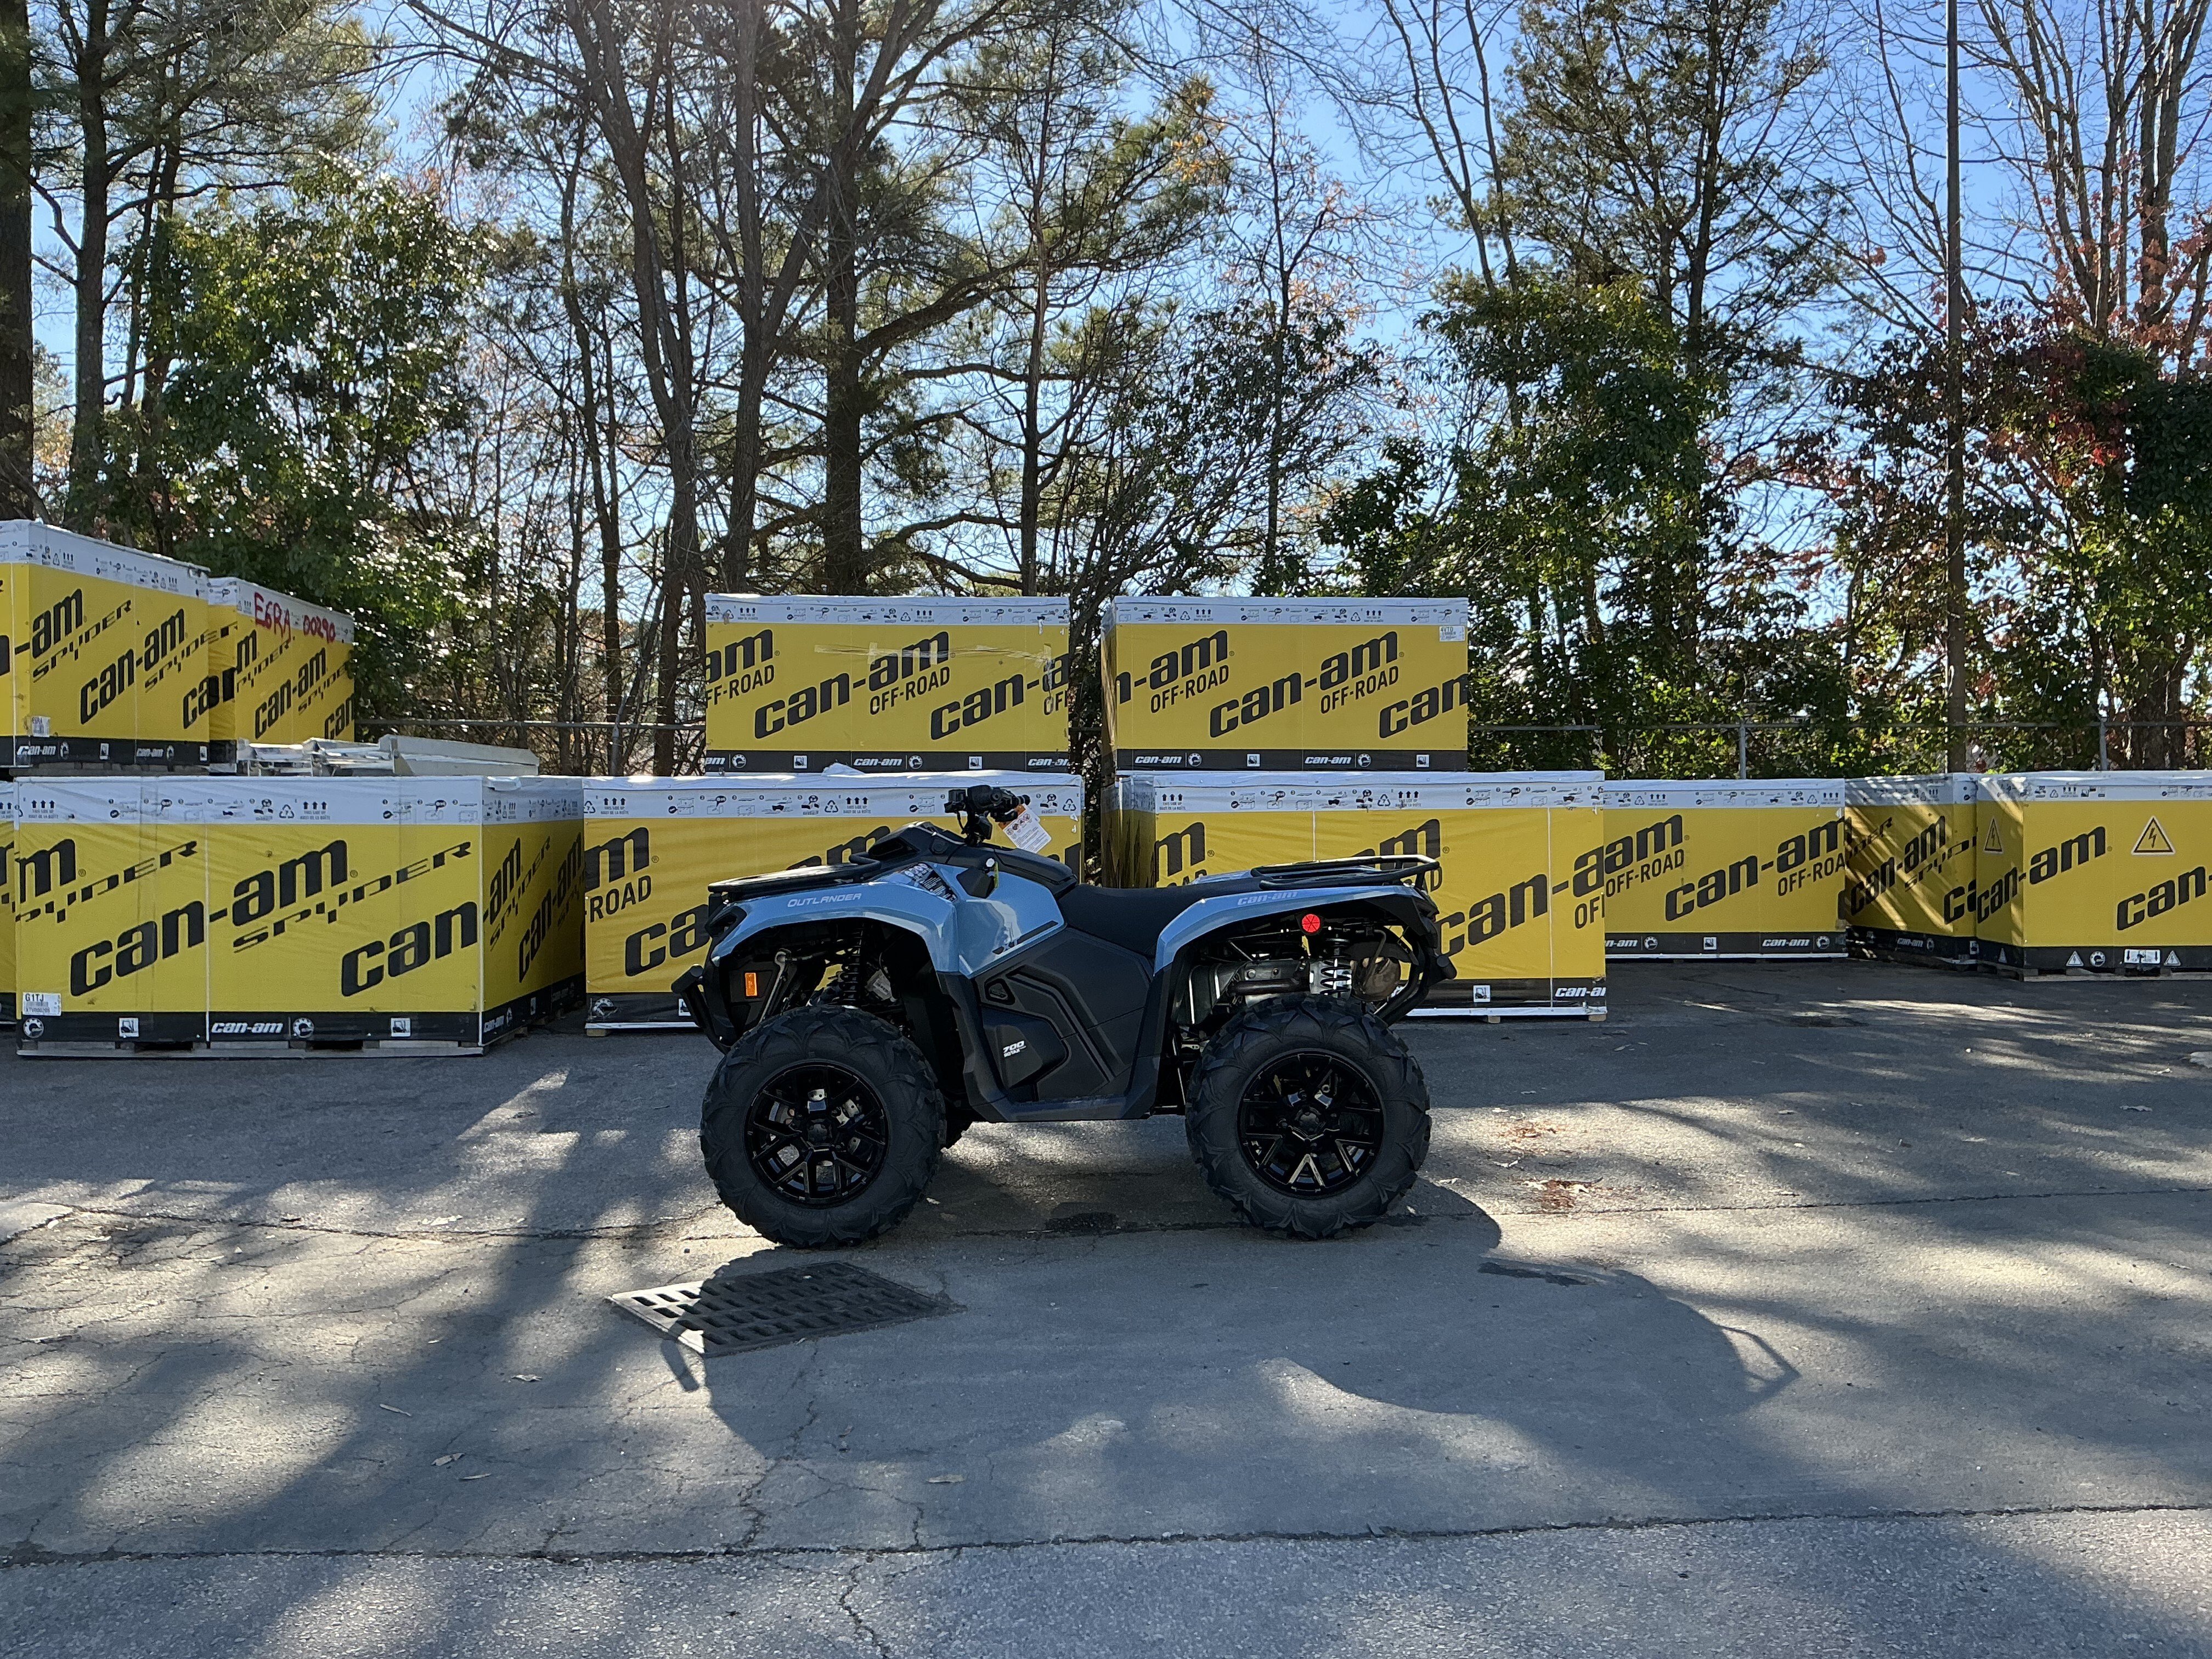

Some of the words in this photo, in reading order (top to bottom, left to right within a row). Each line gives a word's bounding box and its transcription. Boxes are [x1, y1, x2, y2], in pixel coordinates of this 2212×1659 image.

[33, 600, 132, 683] SPYDER
[303, 614, 336, 645] 00290
[81, 608, 184, 725] can-am
[755, 631, 949, 740] can-am
[870, 667, 950, 715] OFF-ROAD
[1151, 665, 1229, 713] OFF-ROAD
[1210, 631, 1397, 738] can-am
[1321, 665, 1398, 714] OFF-ROAD
[255, 647, 327, 739] can-am
[854, 758, 903, 766] can-am
[1135, 755, 1182, 764] can-am
[1305, 755, 1352, 764] can-am
[1606, 849, 1685, 898] OFF-ROAD
[1850, 815, 1946, 917] can-am
[1977, 826, 2106, 924] can-am
[70, 839, 348, 996] can-am
[233, 841, 472, 953] SPYDER
[490, 836, 551, 952] SPYDER
[518, 832, 582, 983] can-am
[787, 893, 862, 908] OUTLANDER
[1237, 891, 1299, 906] can-am
[1762, 938, 1810, 947] can-am
[211, 1022, 284, 1034] can-am
[1003, 1040, 1025, 1053] 700
